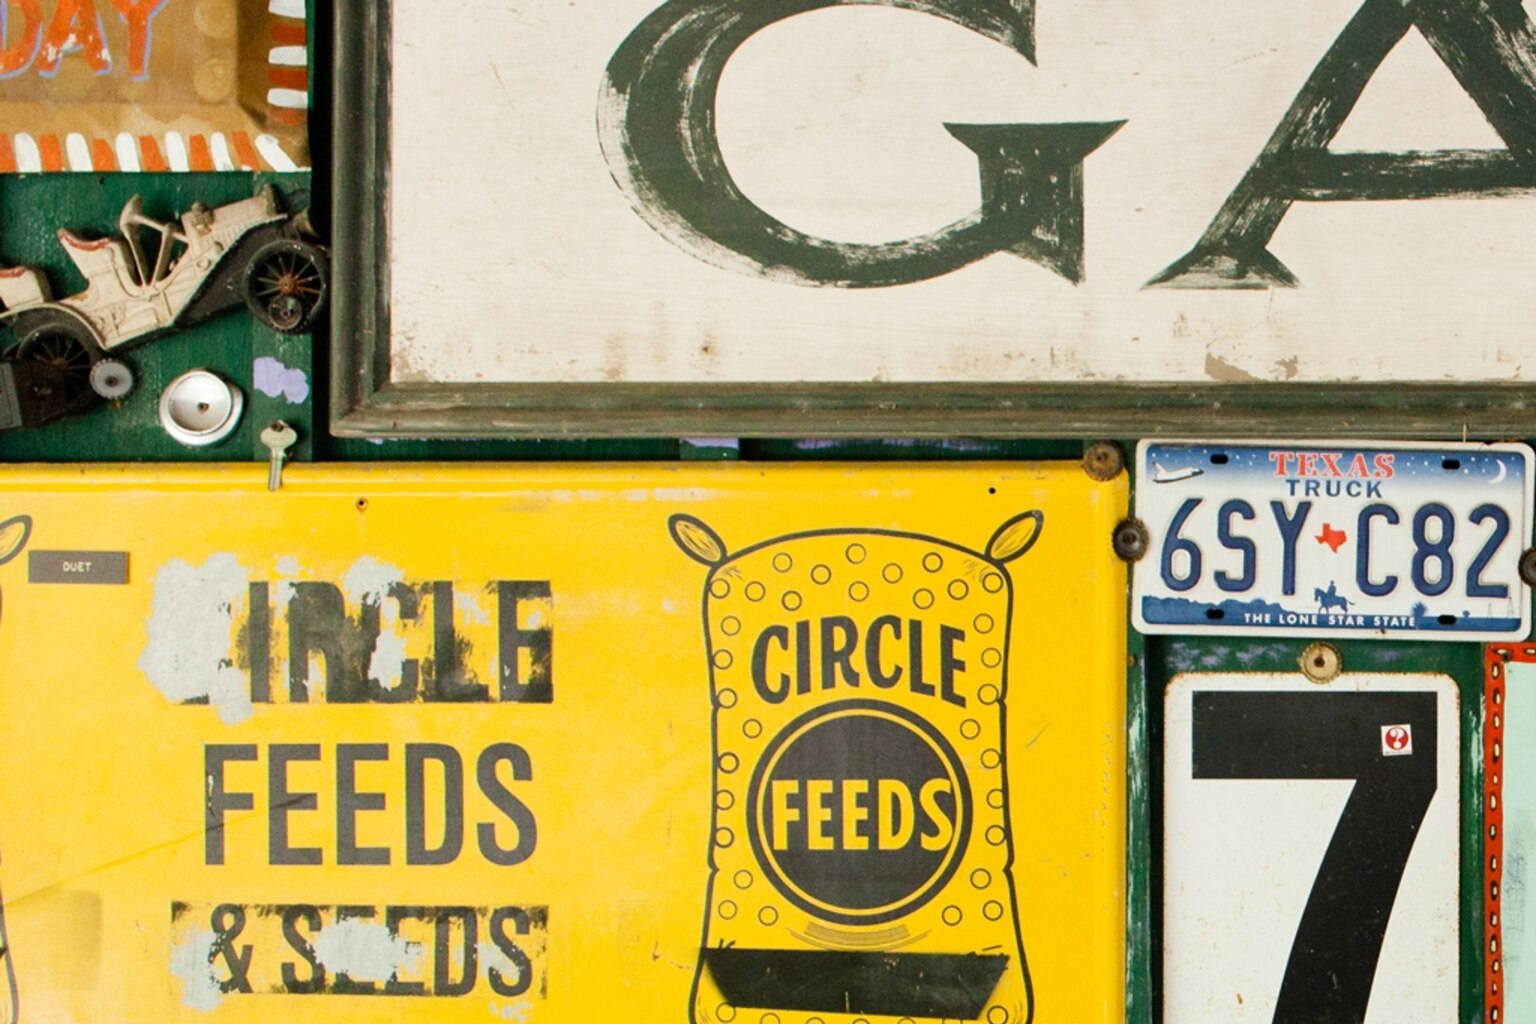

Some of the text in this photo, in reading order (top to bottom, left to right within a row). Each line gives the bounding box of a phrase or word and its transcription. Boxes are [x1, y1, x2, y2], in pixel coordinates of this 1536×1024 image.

[1269, 451, 1396, 479] TEXAS
[1286, 479, 1383, 499] TRUCK
[62, 561, 93, 572] DUET
[1160, 499, 1511, 598] 6SY C82
[1244, 612, 1417, 628] THE LONE STAR STATE
[751, 613, 967, 708] CIRCLE
[204, 742, 538, 866] FEEDS
[771, 778, 955, 852] FEEDS
[208, 904, 255, 994] &
